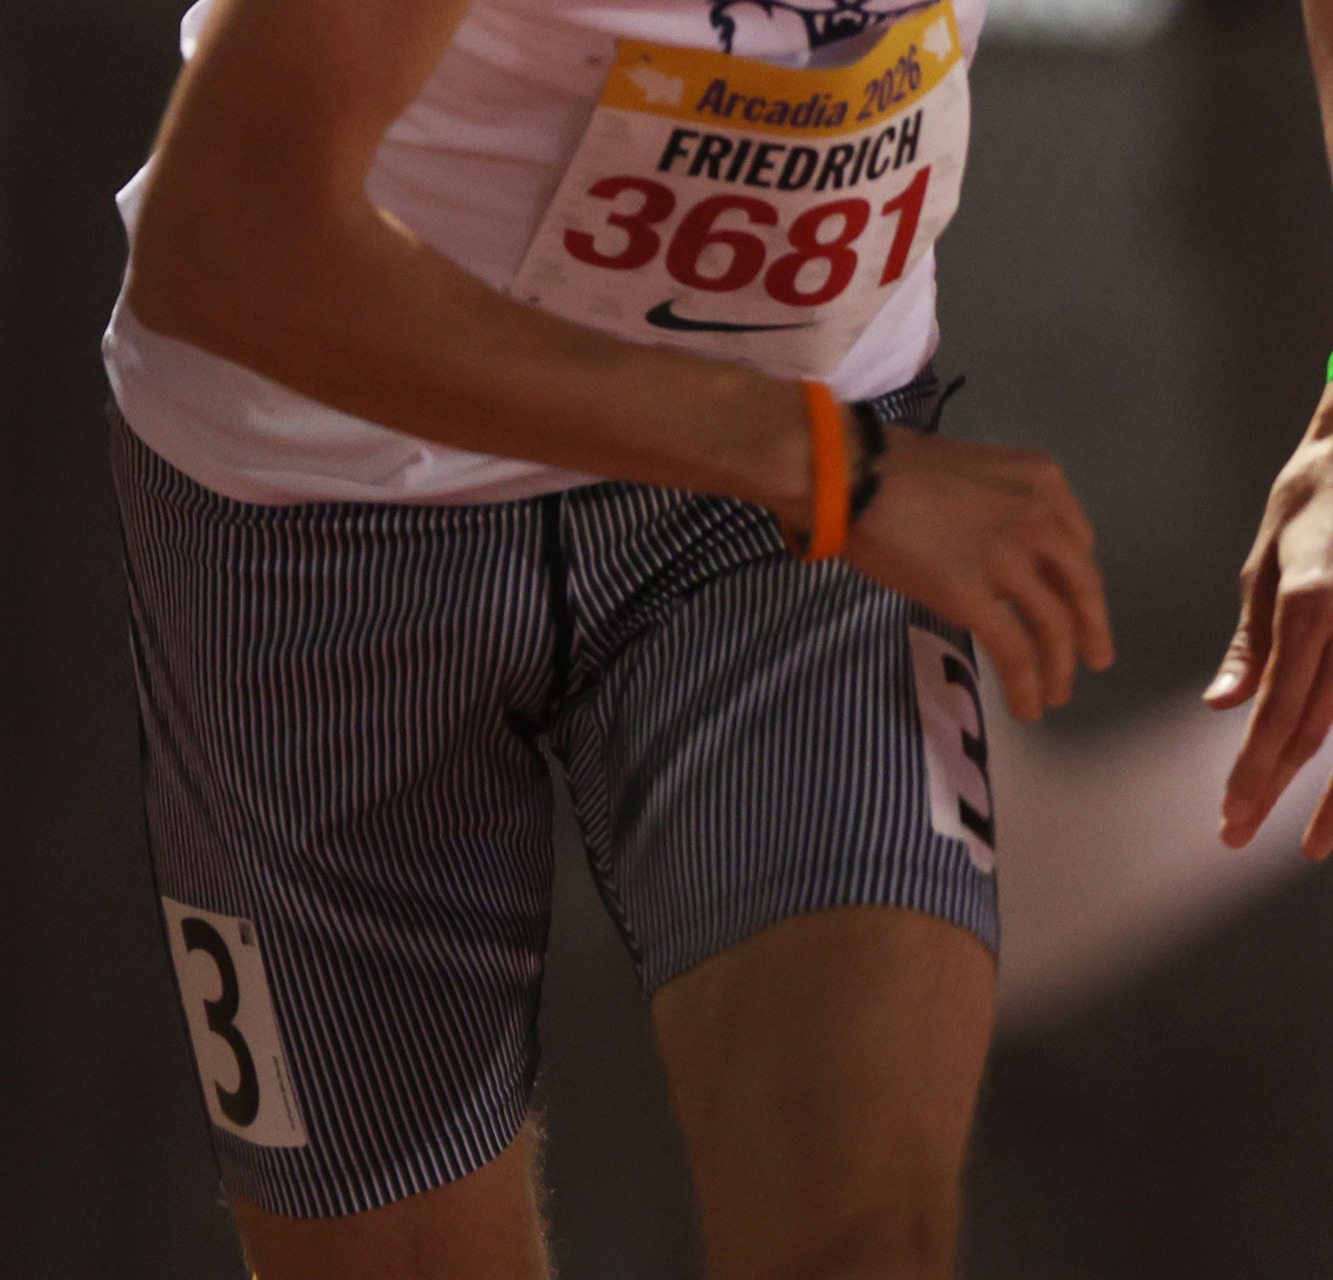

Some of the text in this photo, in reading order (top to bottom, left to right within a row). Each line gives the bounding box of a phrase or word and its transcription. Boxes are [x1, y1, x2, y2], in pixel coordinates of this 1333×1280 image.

[657, 109, 924, 193] FRIEDRICH
[696, 43, 924, 129] Arcadia 2026
[562, 164, 933, 308] 3681
[942, 653, 996, 850] 3
[180, 916, 261, 1130] 3
